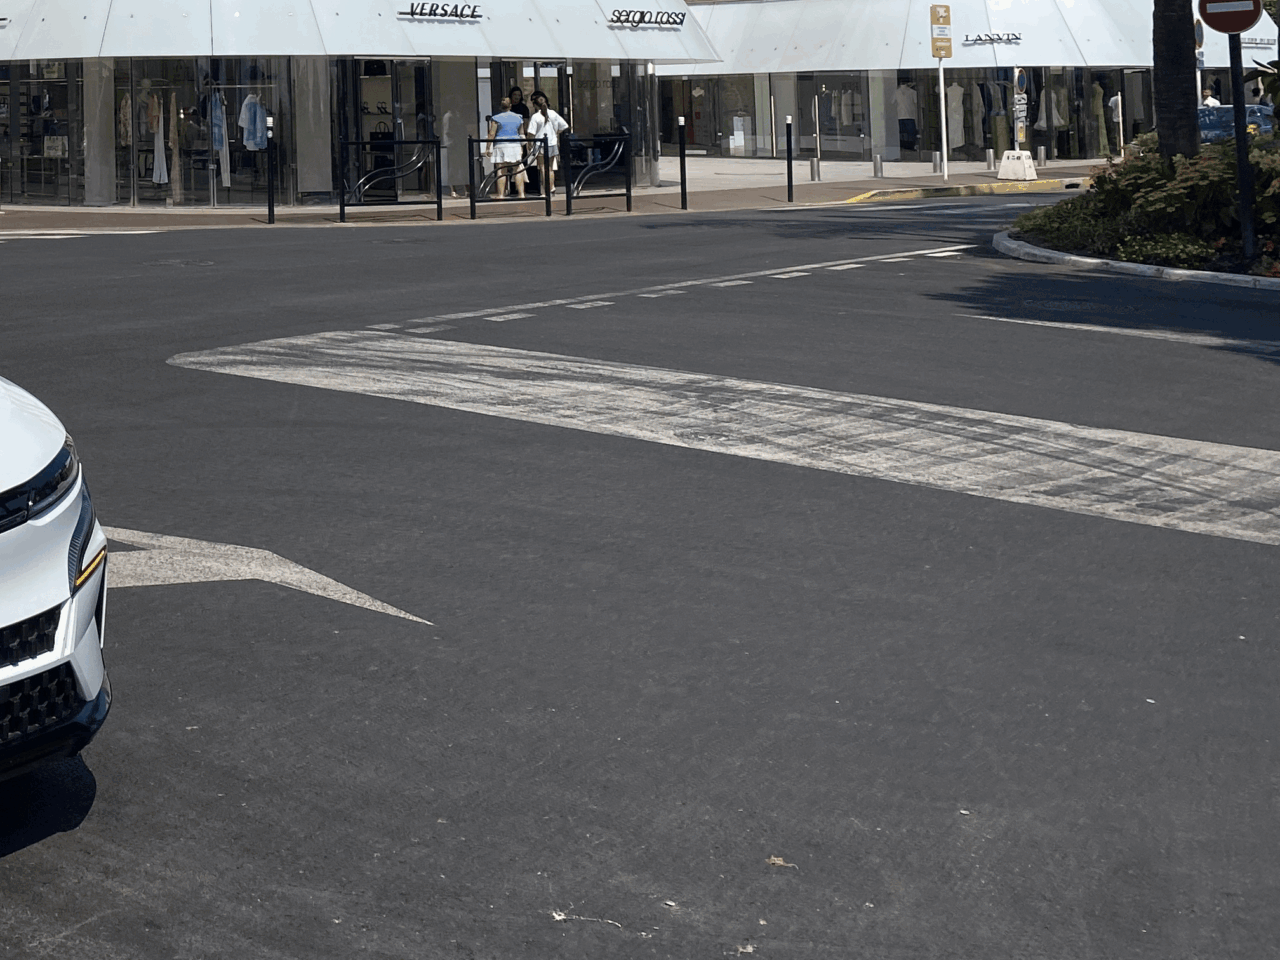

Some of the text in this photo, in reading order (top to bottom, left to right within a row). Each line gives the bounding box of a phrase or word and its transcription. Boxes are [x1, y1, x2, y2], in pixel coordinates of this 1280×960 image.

[410, 2, 482, 19] VERSACE
[610, 9, 687, 28] sergio rossi
[963, 32, 1023, 43] LANVIN
